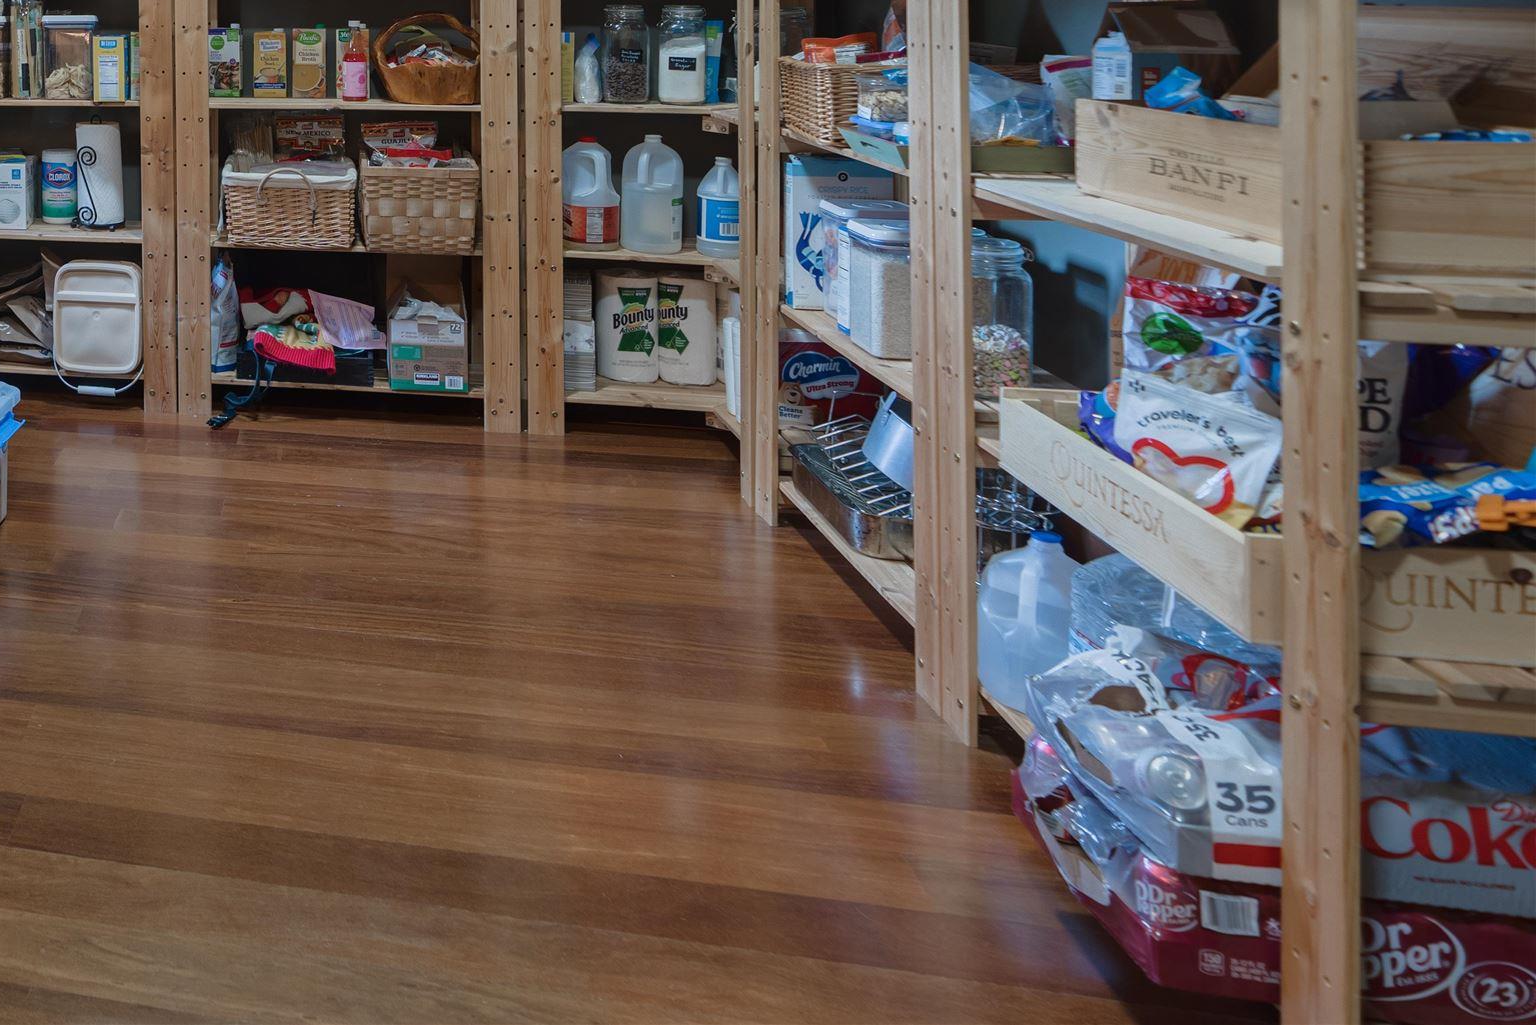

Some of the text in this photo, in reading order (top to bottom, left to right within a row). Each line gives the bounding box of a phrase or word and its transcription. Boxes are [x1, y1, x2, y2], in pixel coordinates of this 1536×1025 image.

[48, 172, 71, 181] CLOROX
[1148, 157, 1250, 196] BANFI
[612, 307, 655, 329] Bounty
[658, 305, 688, 321] unty
[450, 323, 461, 331] 72
[789, 360, 841, 379] Charmin
[806, 380, 855, 393] Ultra Strong
[778, 405, 803, 414] Cleans
[1050, 440, 1169, 544] QUINTESSA
[1216, 781, 1276, 814] 35
[1225, 814, 1268, 828] Cans
[1360, 795, 1536, 870] Cok
[1360, 941, 1452, 989] pper
[1480, 977, 1518, 1008] 23
